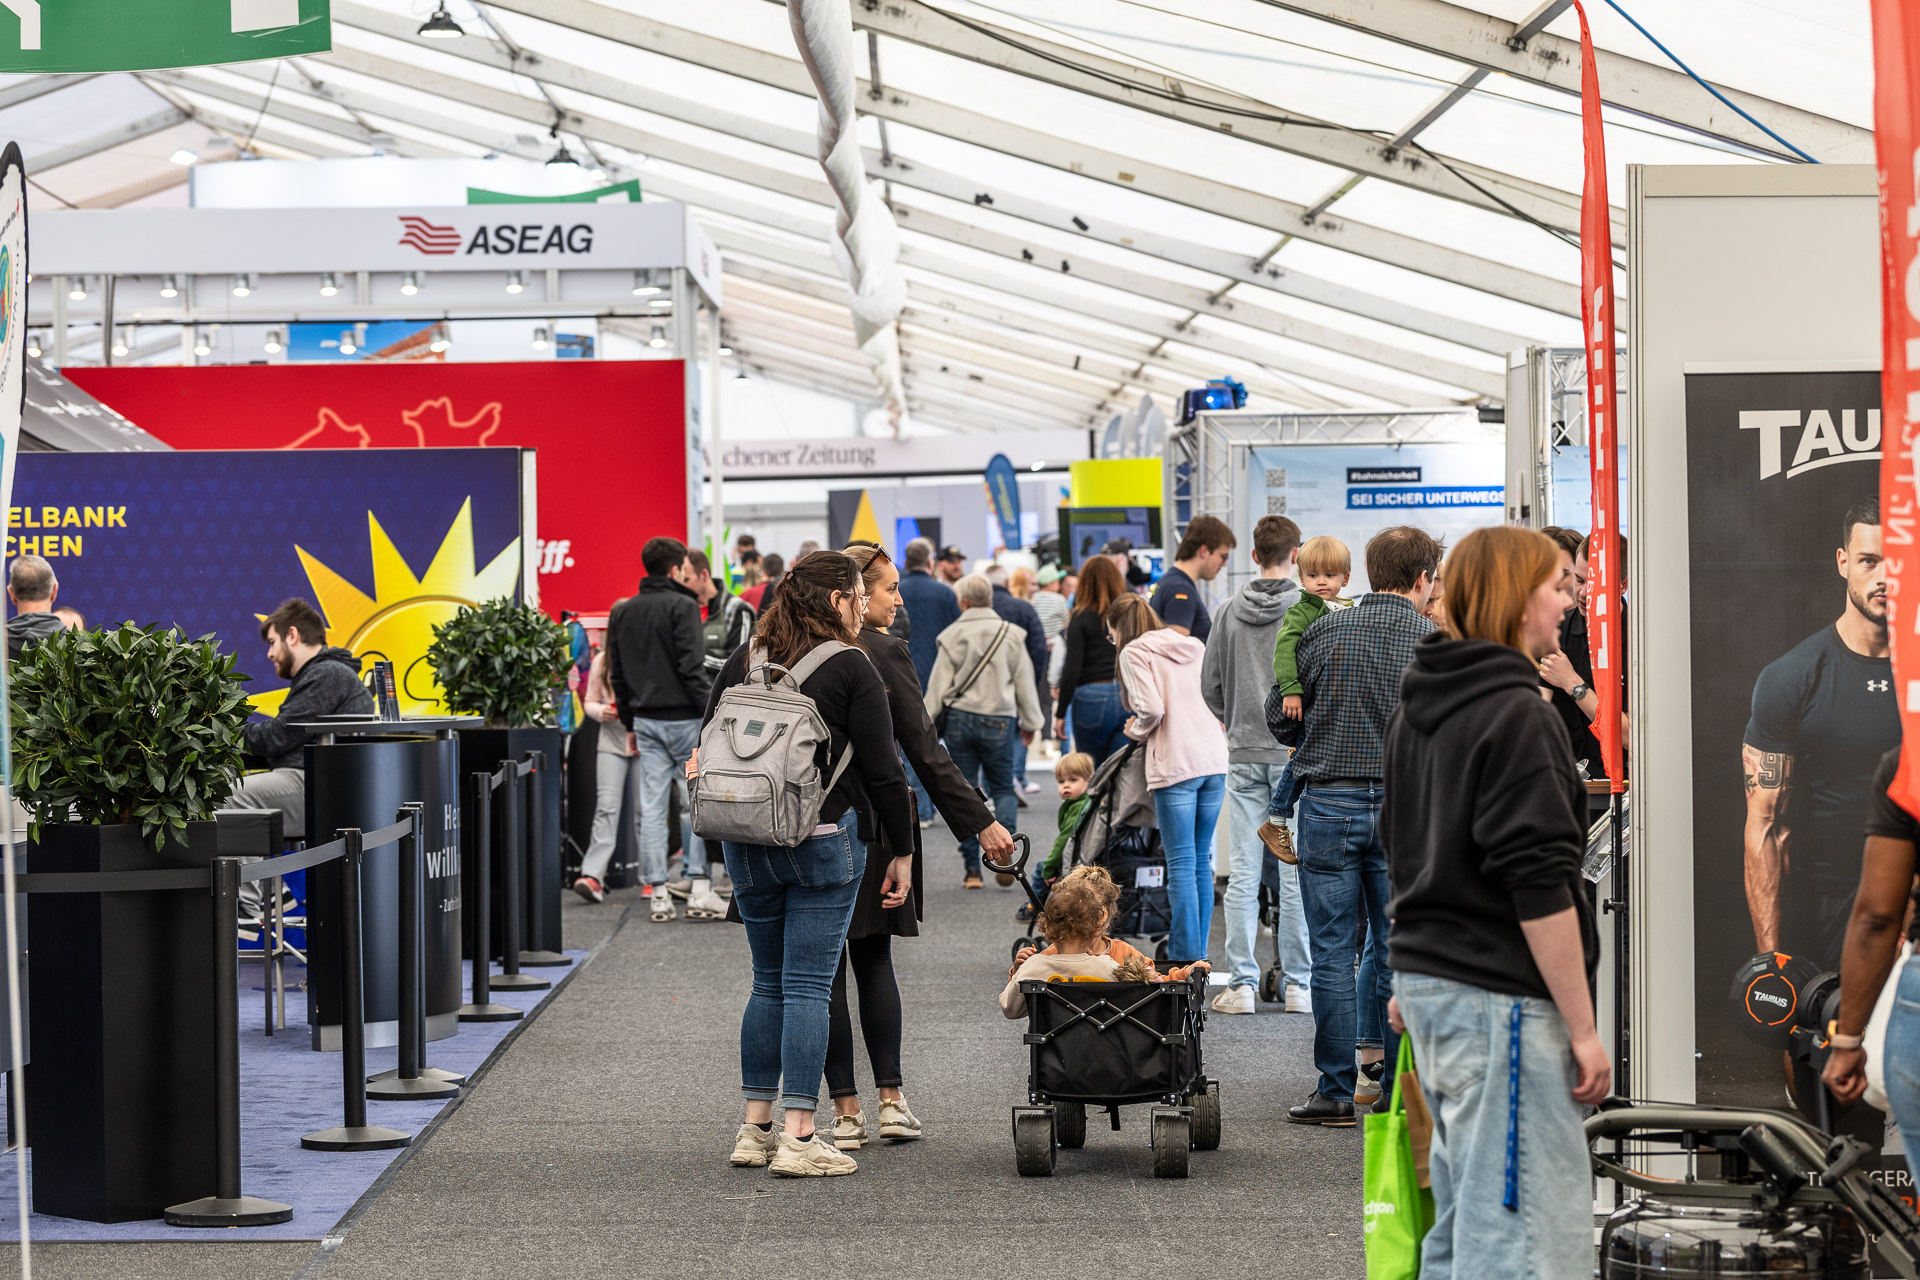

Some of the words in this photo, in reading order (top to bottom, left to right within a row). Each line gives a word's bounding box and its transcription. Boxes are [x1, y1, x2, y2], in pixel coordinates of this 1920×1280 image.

[466, 224, 594, 255] ASEAG
[797, 443, 876, 469] Zeitung
[1350, 470, 1419, 481] #bahnsicherheit
[1351, 493, 1373, 506] SEI
[1375, 491, 1424, 505] SICHER
[1754, 990, 1788, 1008] TAURUS
